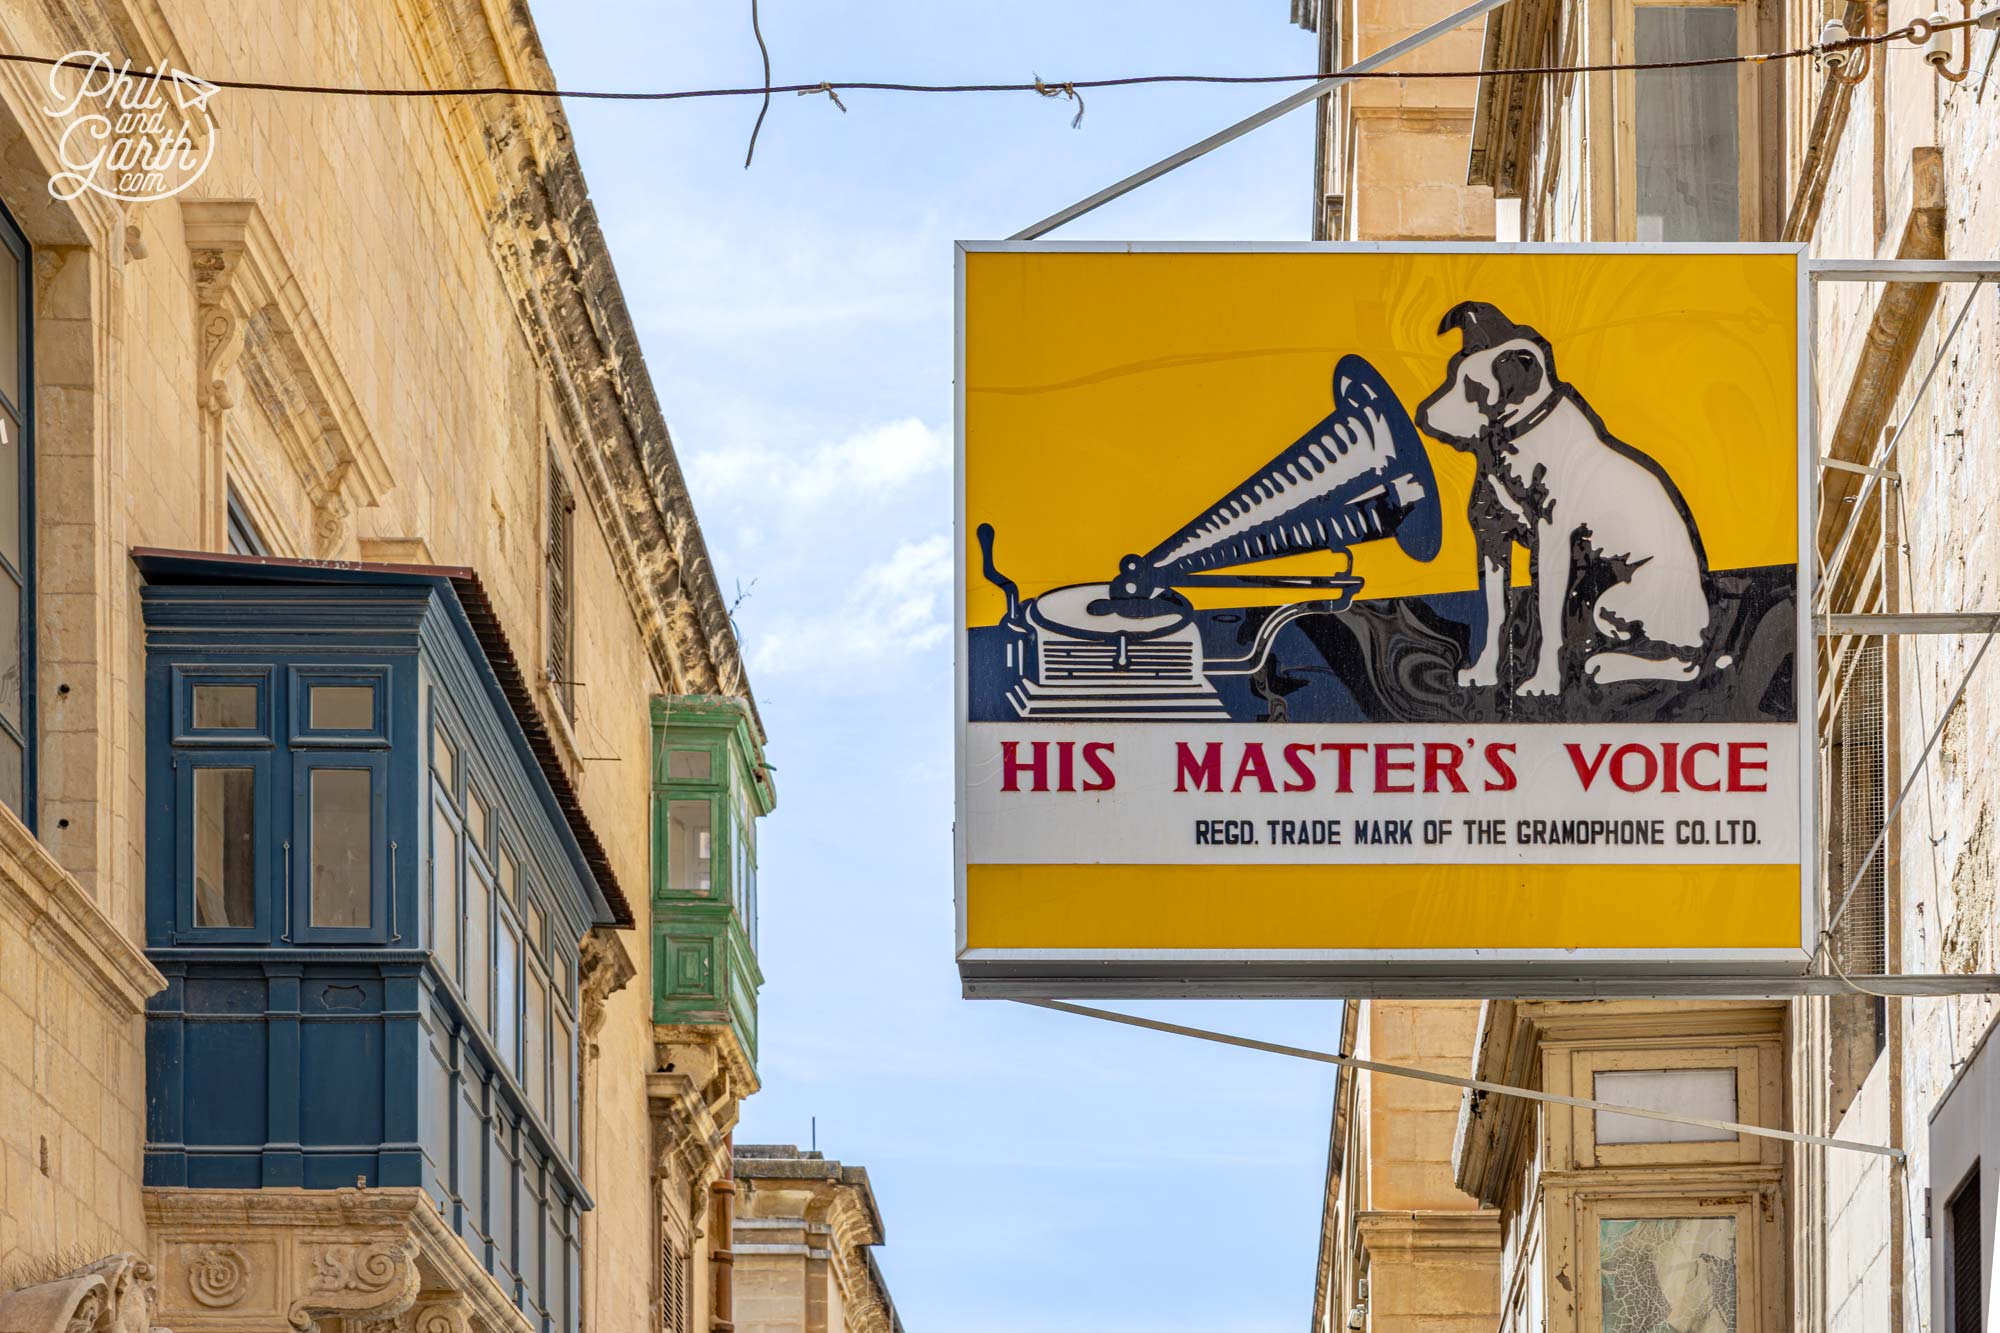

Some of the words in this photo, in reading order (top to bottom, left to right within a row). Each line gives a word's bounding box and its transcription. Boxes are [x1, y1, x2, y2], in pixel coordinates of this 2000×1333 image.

[999, 741, 1117, 793] HIS
[1172, 738, 1518, 794] MASTER'S
[1562, 741, 1769, 794] VOICE
[1195, 819, 1260, 846] REGD.
[1266, 819, 1342, 846] TRADE
[1354, 819, 1414, 846] MARK
[1423, 819, 1453, 846] OF
[1462, 819, 1507, 846] THE
[1516, 819, 1665, 846] GRAMOPHONE
